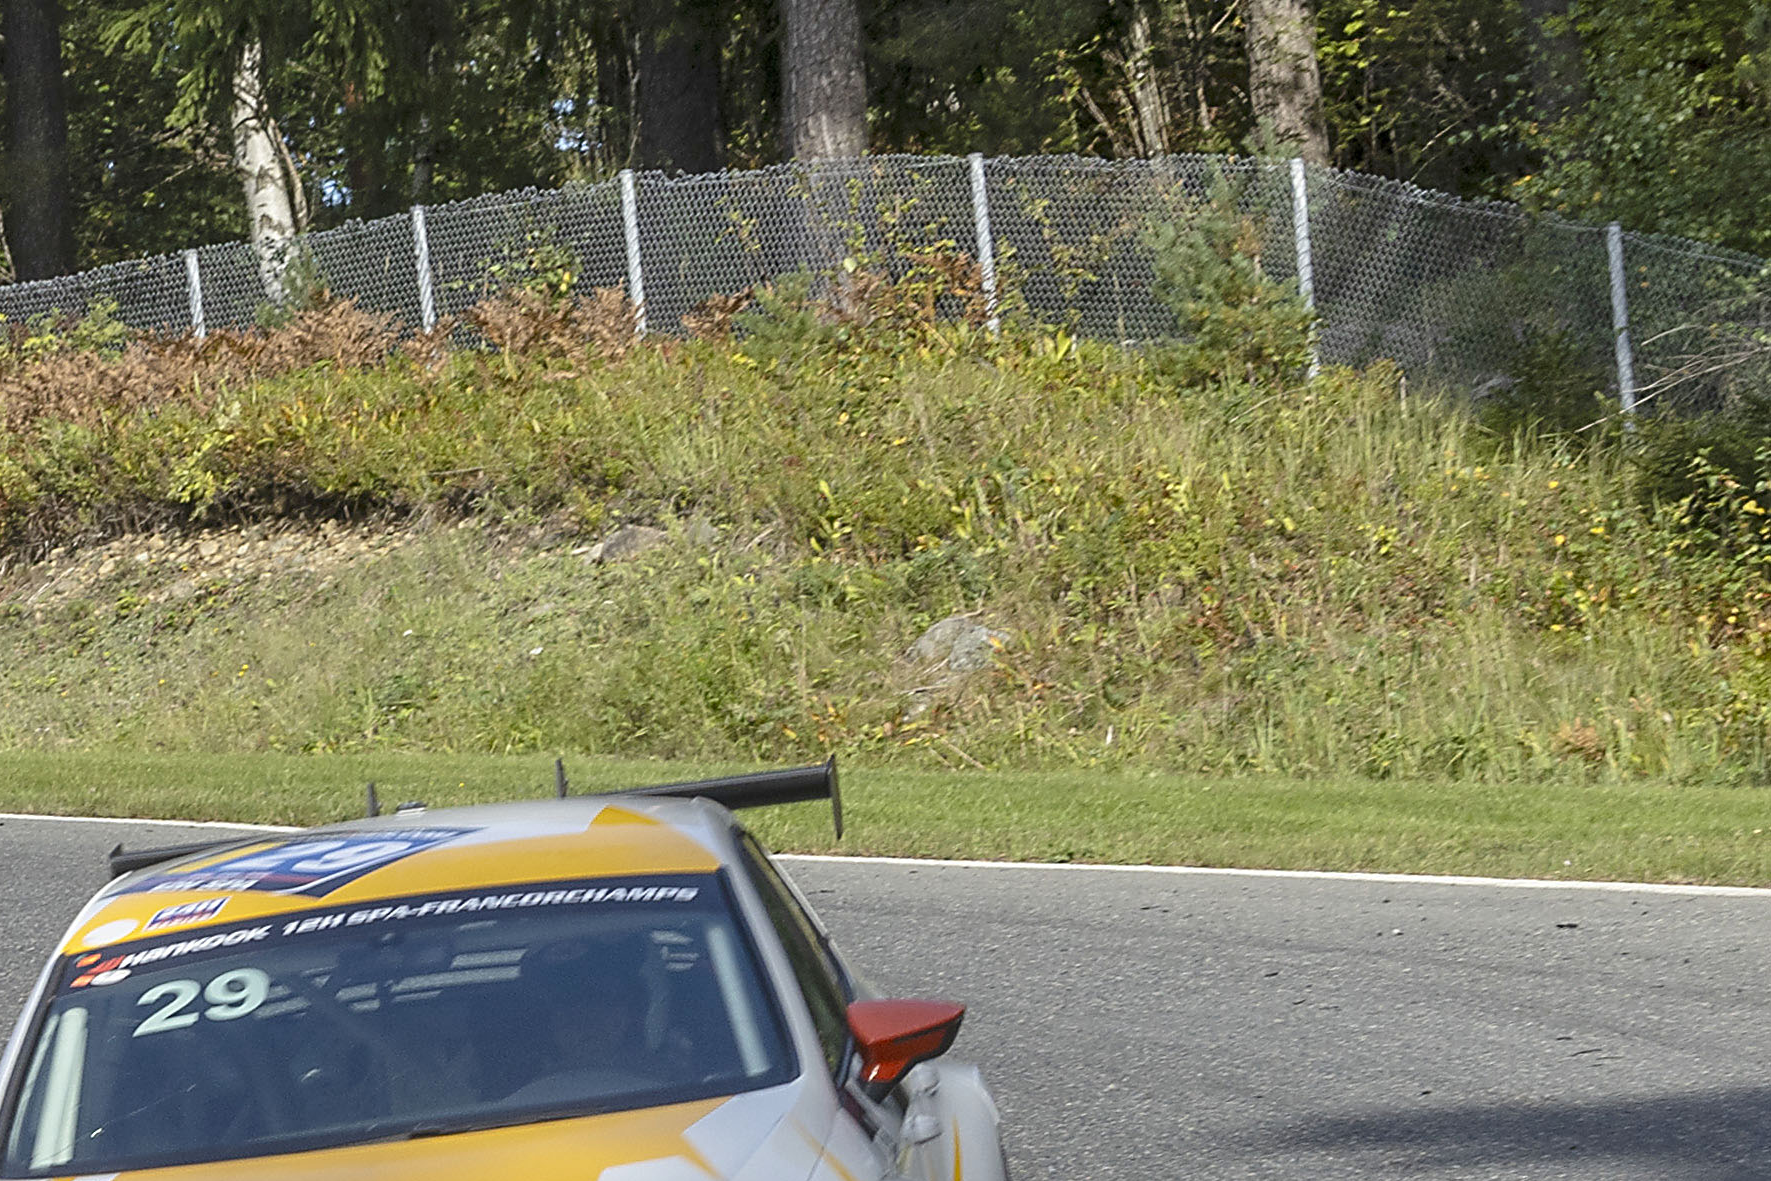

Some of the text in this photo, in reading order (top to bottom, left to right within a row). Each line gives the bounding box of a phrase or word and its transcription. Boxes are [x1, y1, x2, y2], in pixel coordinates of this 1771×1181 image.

[282, 912, 346, 937] 12H
[345, 886, 699, 927] SPA-FRANCORCHAMPS
[132, 967, 271, 1039] 29
